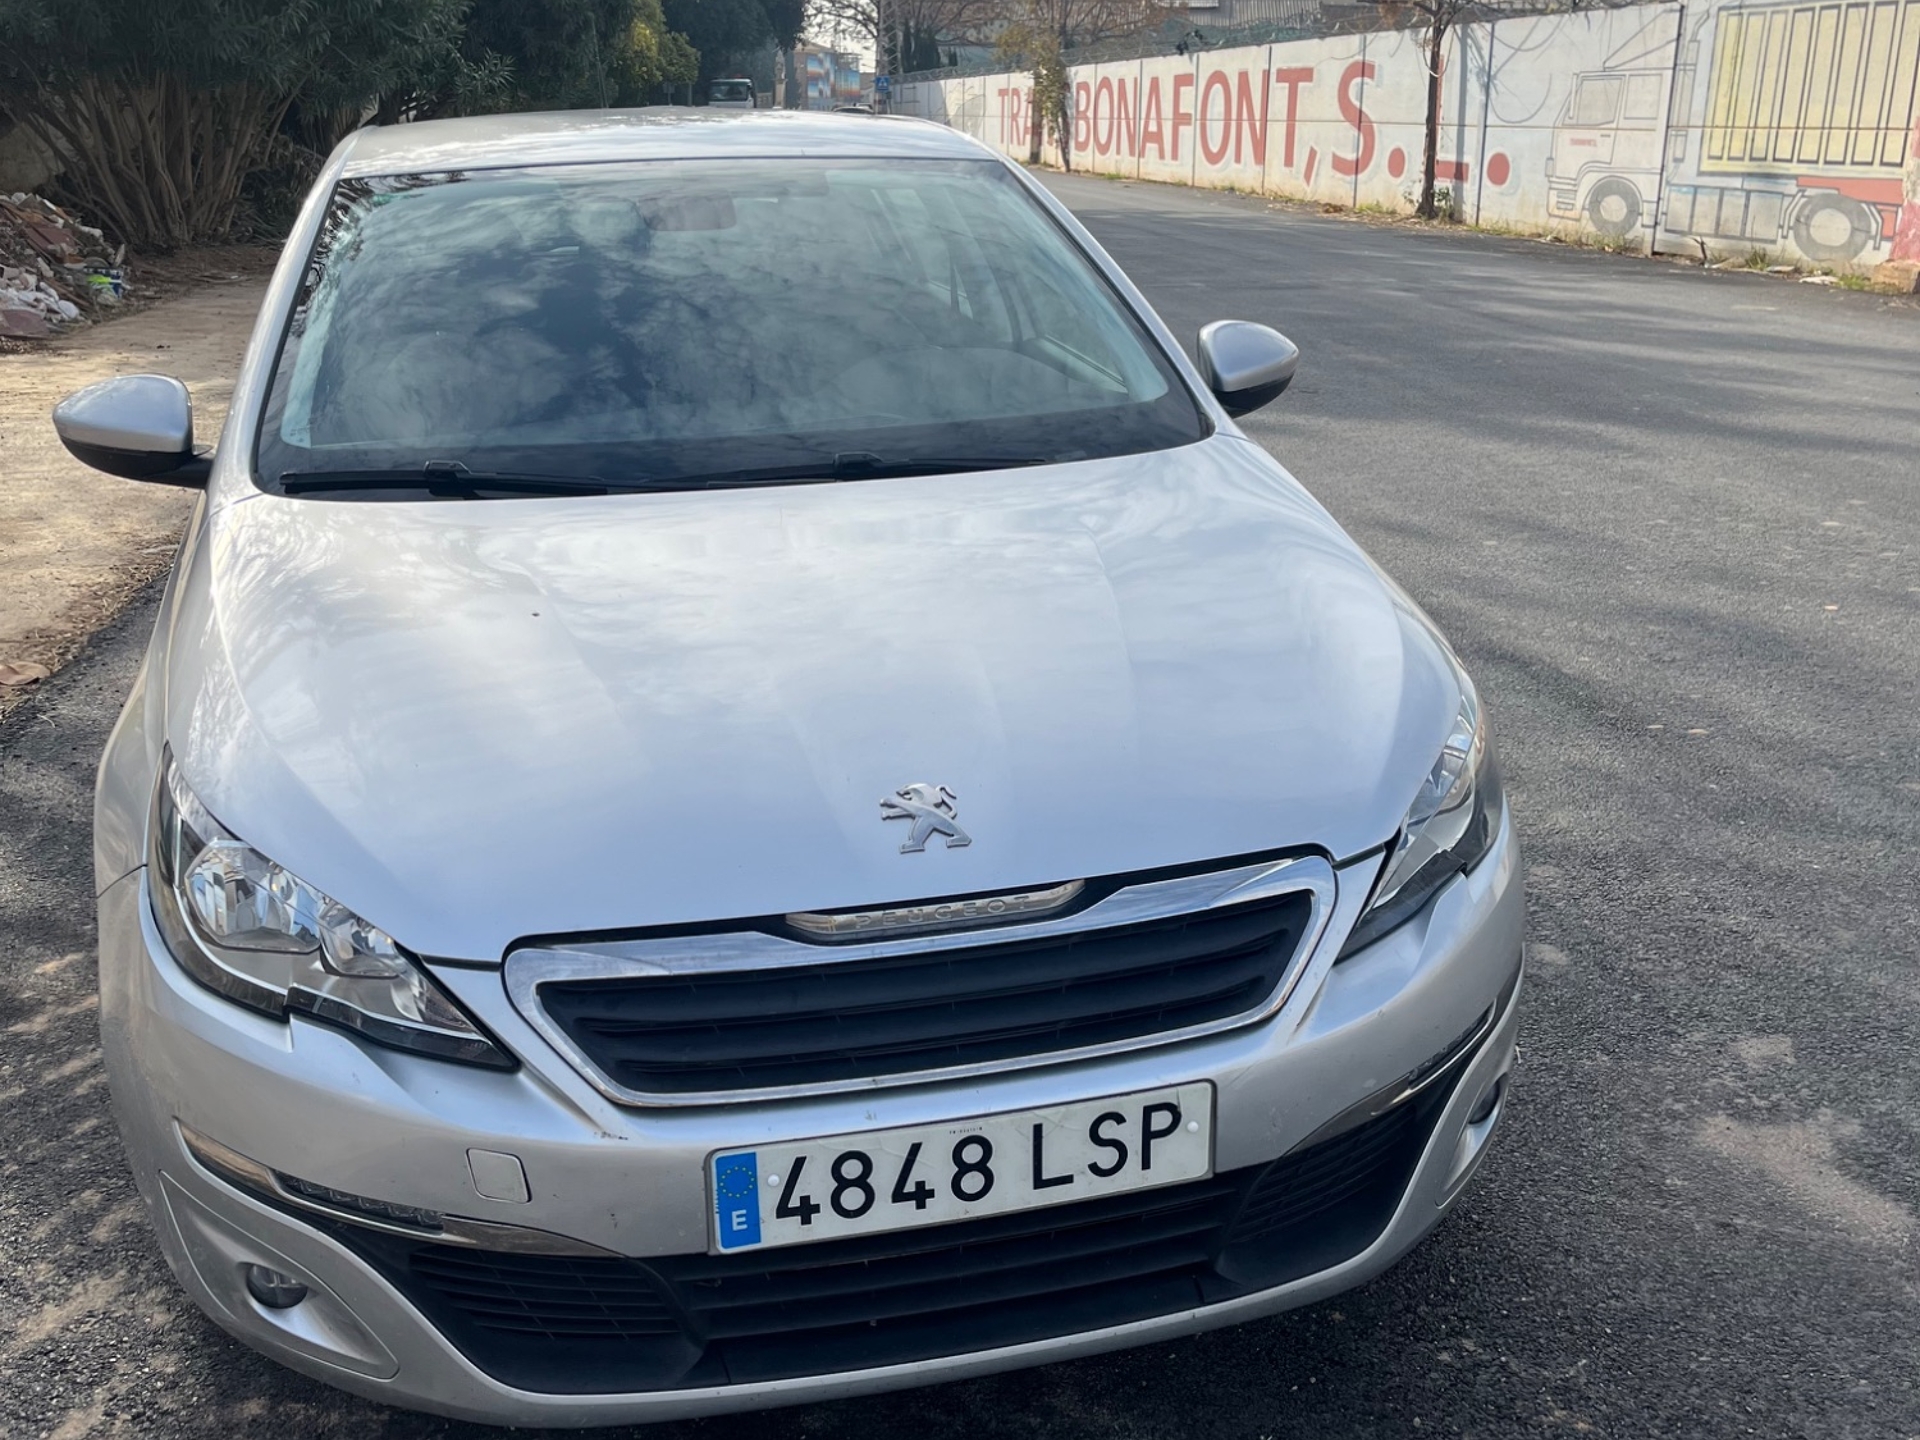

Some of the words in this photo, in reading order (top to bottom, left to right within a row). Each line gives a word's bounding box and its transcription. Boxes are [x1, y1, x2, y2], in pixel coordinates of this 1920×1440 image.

[854, 895, 1030, 929] PEUGEOT
[775, 1134, 995, 1226] 4848
[1032, 1101, 1182, 1191] LSP
[731, 1209, 748, 1231] E
